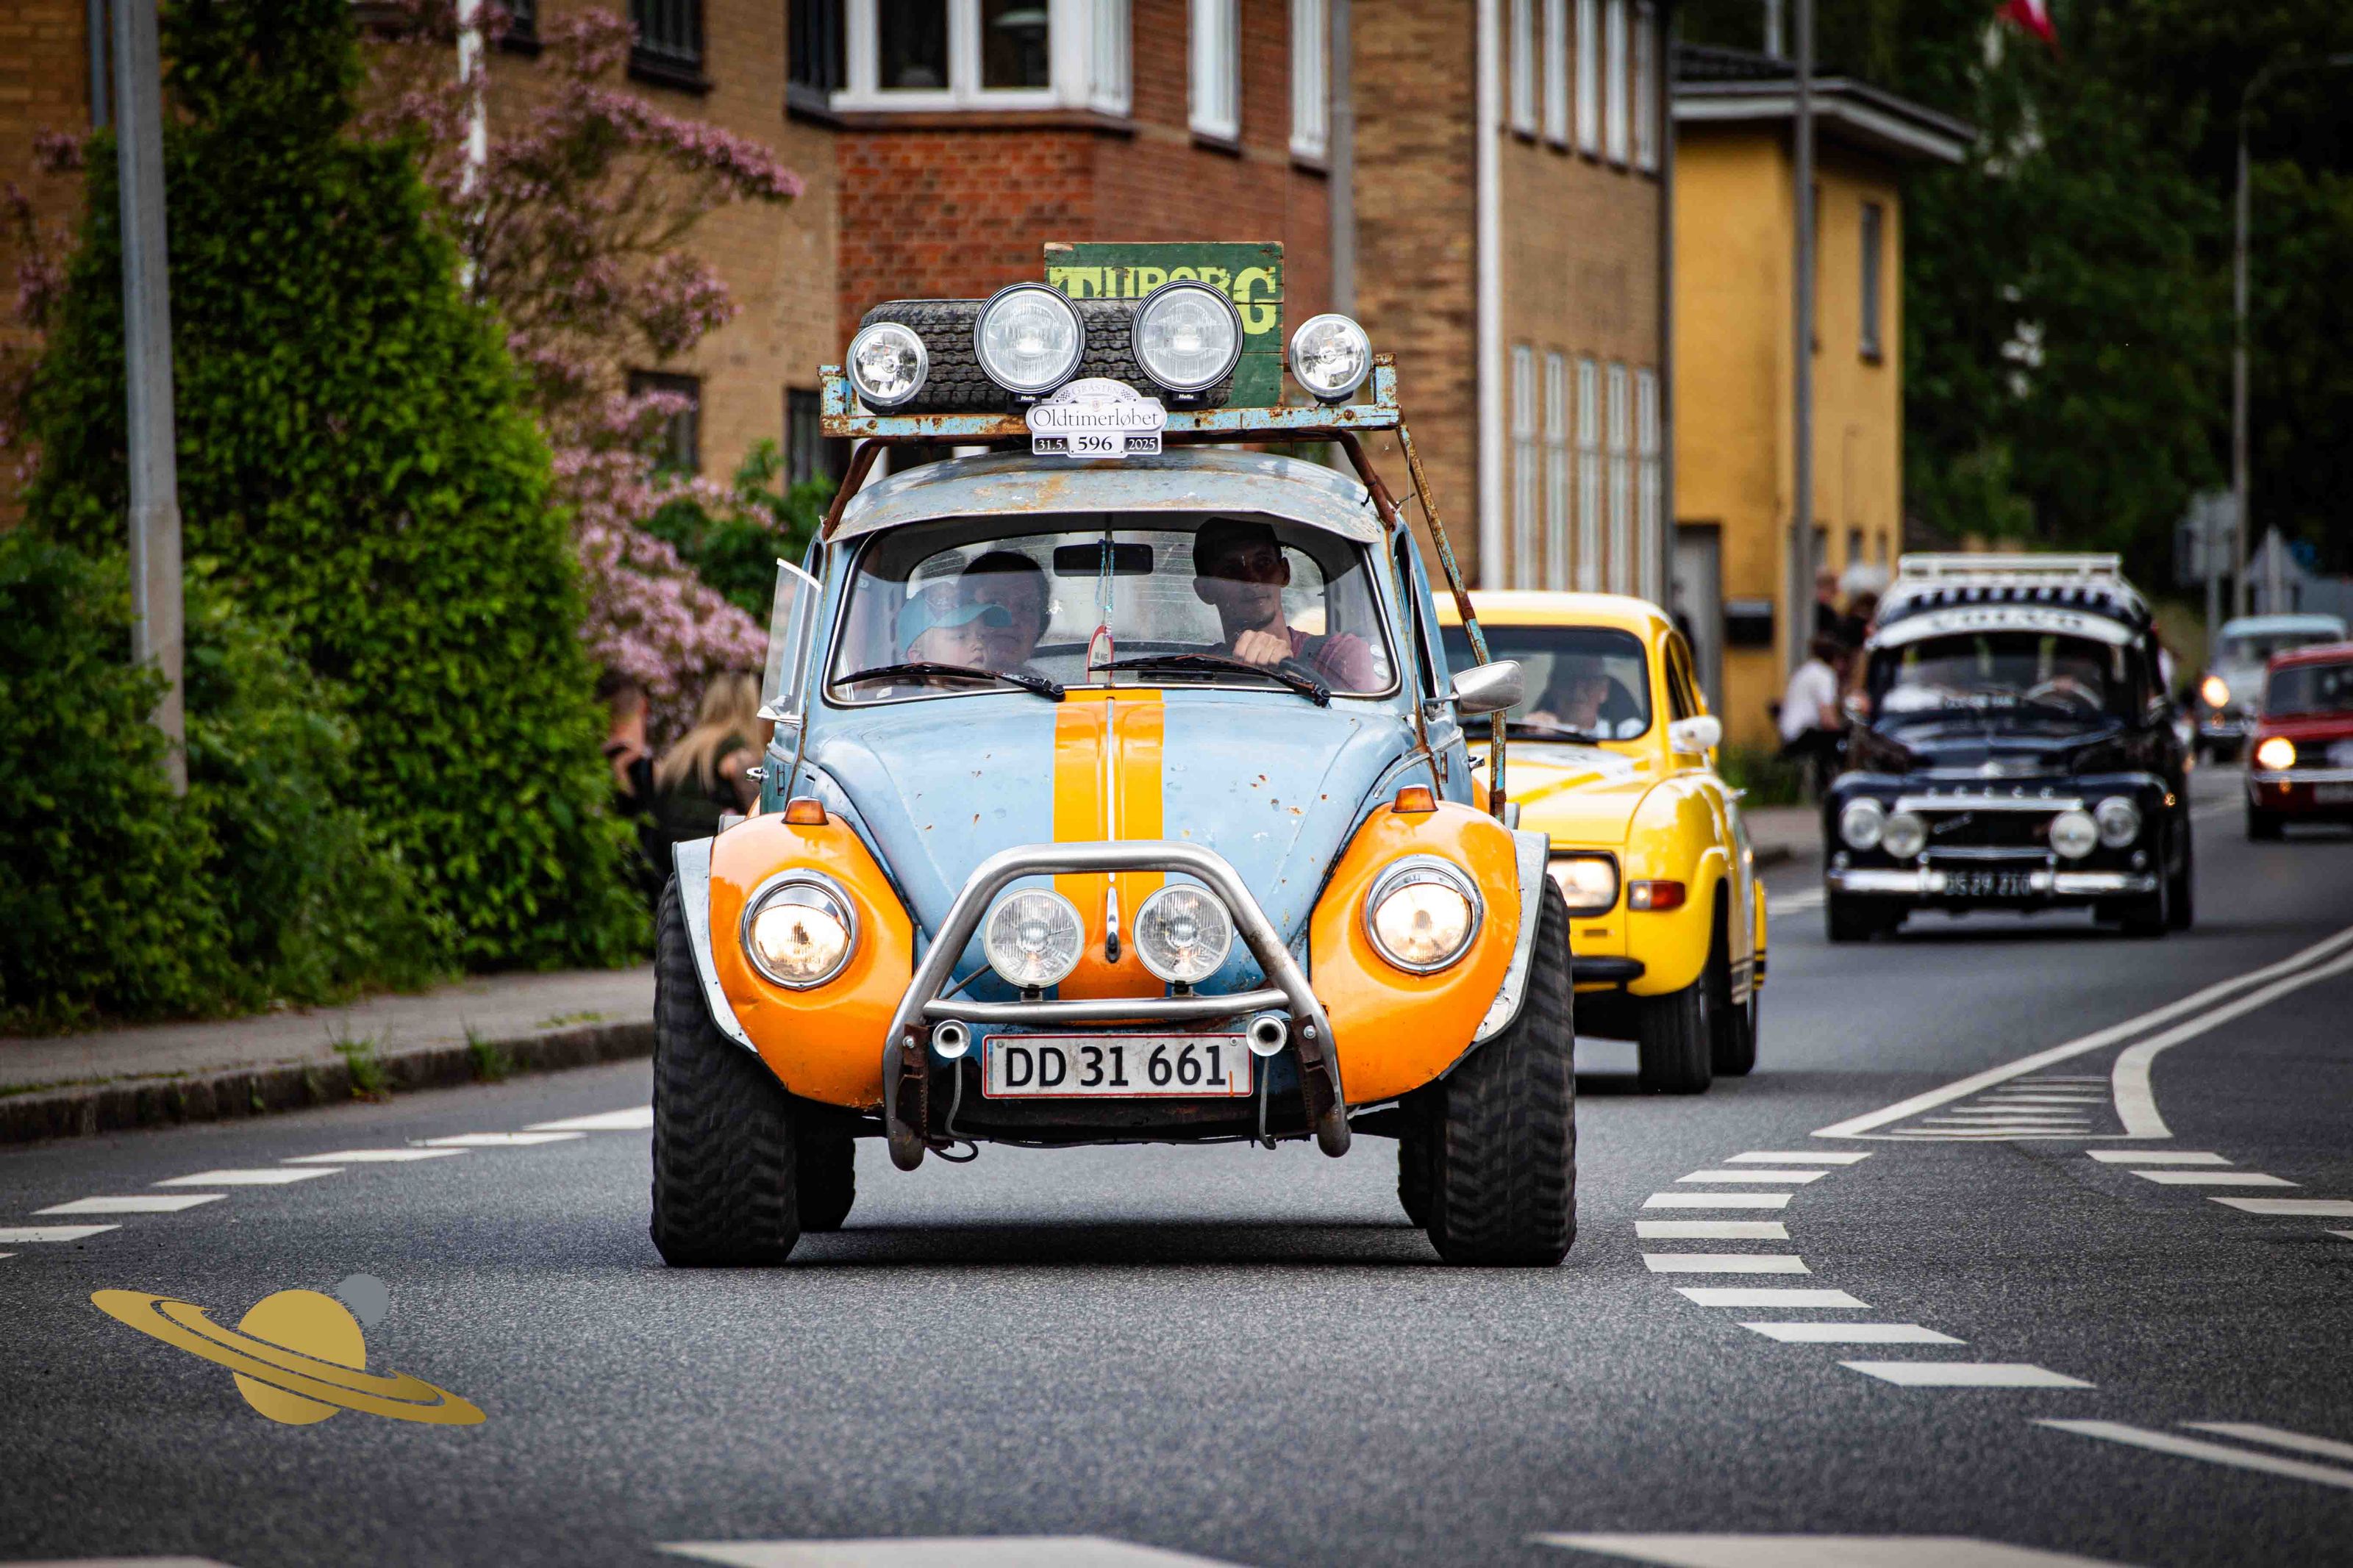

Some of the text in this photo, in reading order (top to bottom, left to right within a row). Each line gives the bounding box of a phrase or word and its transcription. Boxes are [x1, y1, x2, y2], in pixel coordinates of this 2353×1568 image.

[1033, 407, 1160, 428] Oldtimerløbet
[1038, 435, 1156, 451] 31.5. 596 2025
[1006, 1043, 1226, 1087] DD 31 661
